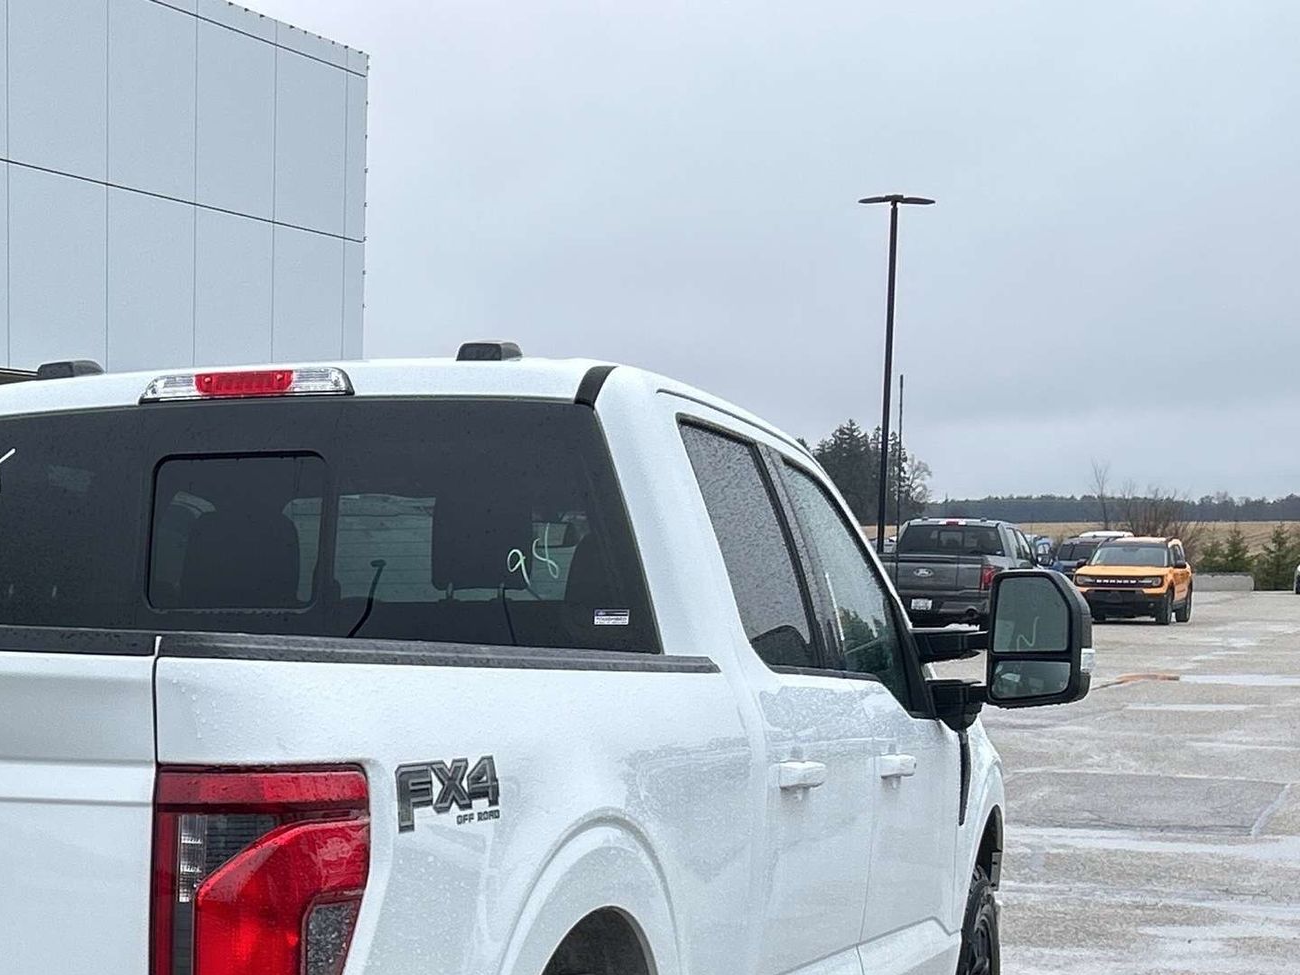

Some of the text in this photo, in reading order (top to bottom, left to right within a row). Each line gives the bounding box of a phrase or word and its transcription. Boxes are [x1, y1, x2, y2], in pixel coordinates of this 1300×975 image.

[395, 755, 499, 833] FX4
[456, 809, 500, 825] OFF ROAD
